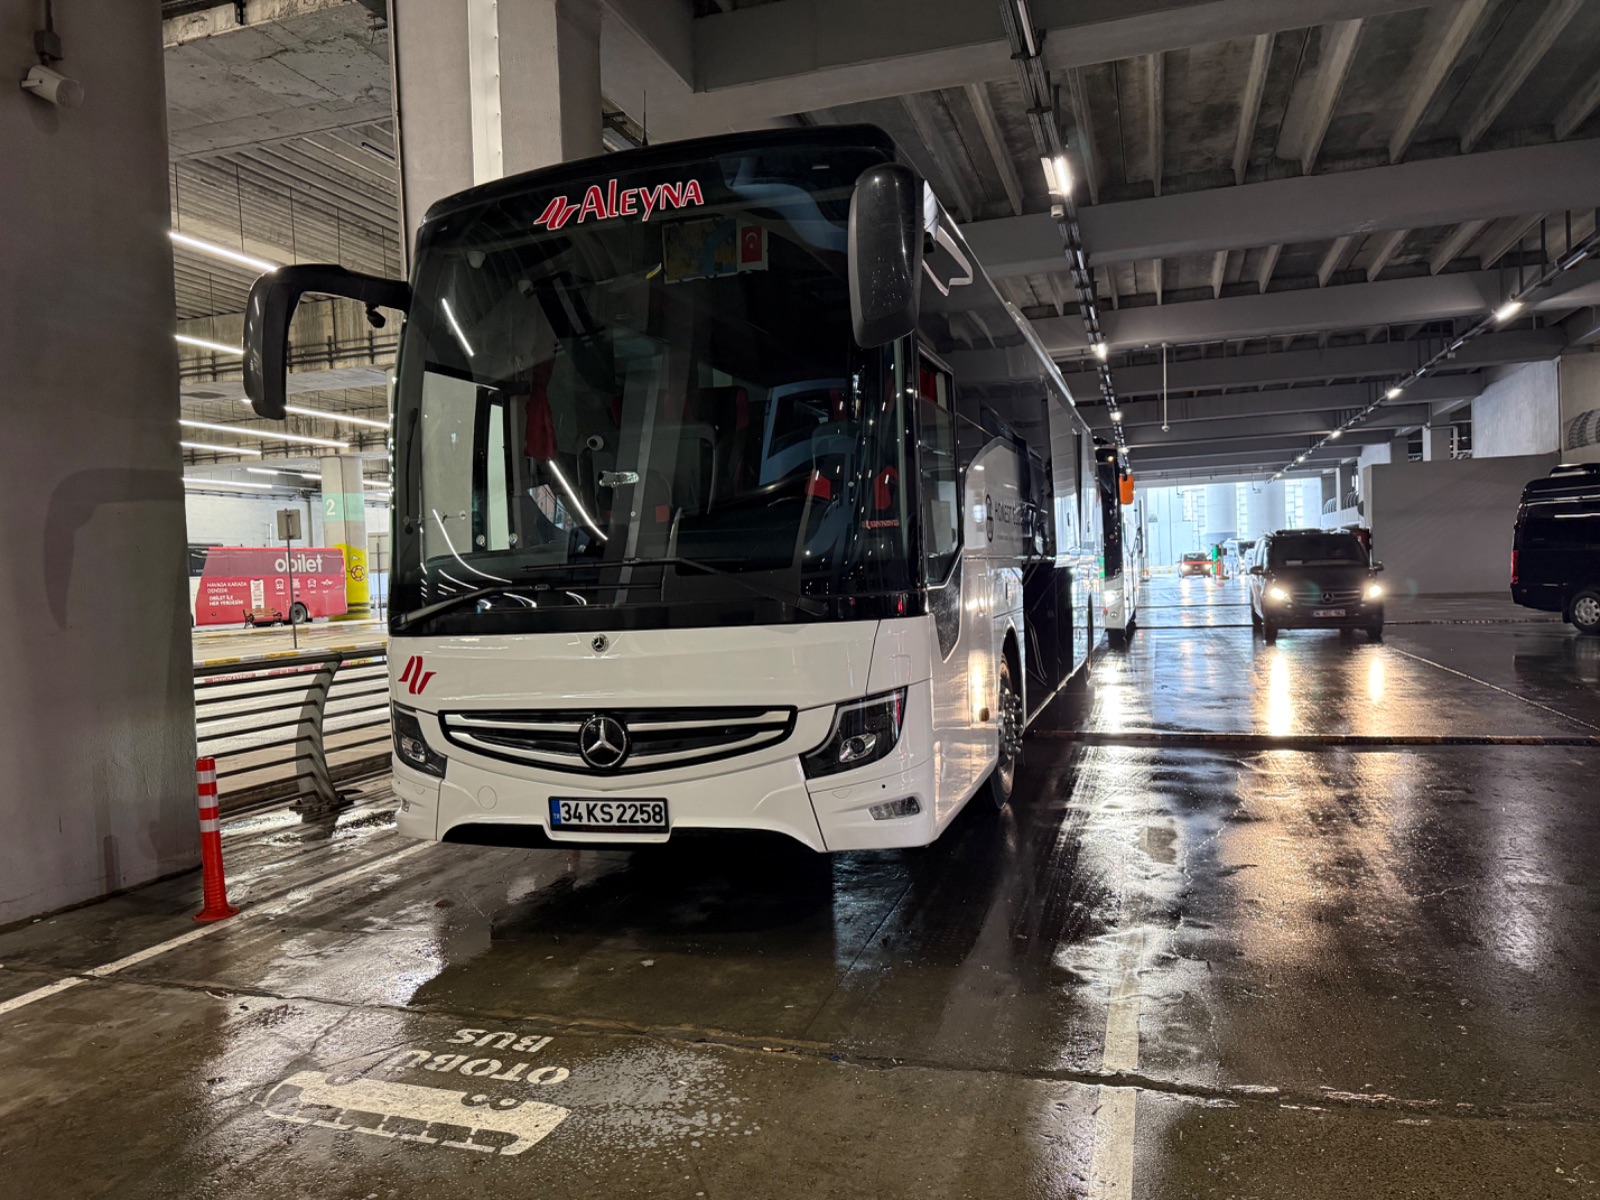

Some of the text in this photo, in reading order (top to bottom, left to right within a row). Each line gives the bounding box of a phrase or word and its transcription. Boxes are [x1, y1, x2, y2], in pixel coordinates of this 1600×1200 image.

[325, 498, 336, 516] 2
[274, 552, 323, 573] obilet
[561, 803, 583, 823] 34
[585, 803, 613, 823] KS
[615, 803, 664, 824] 2258
[446, 1029, 554, 1053] BUS
